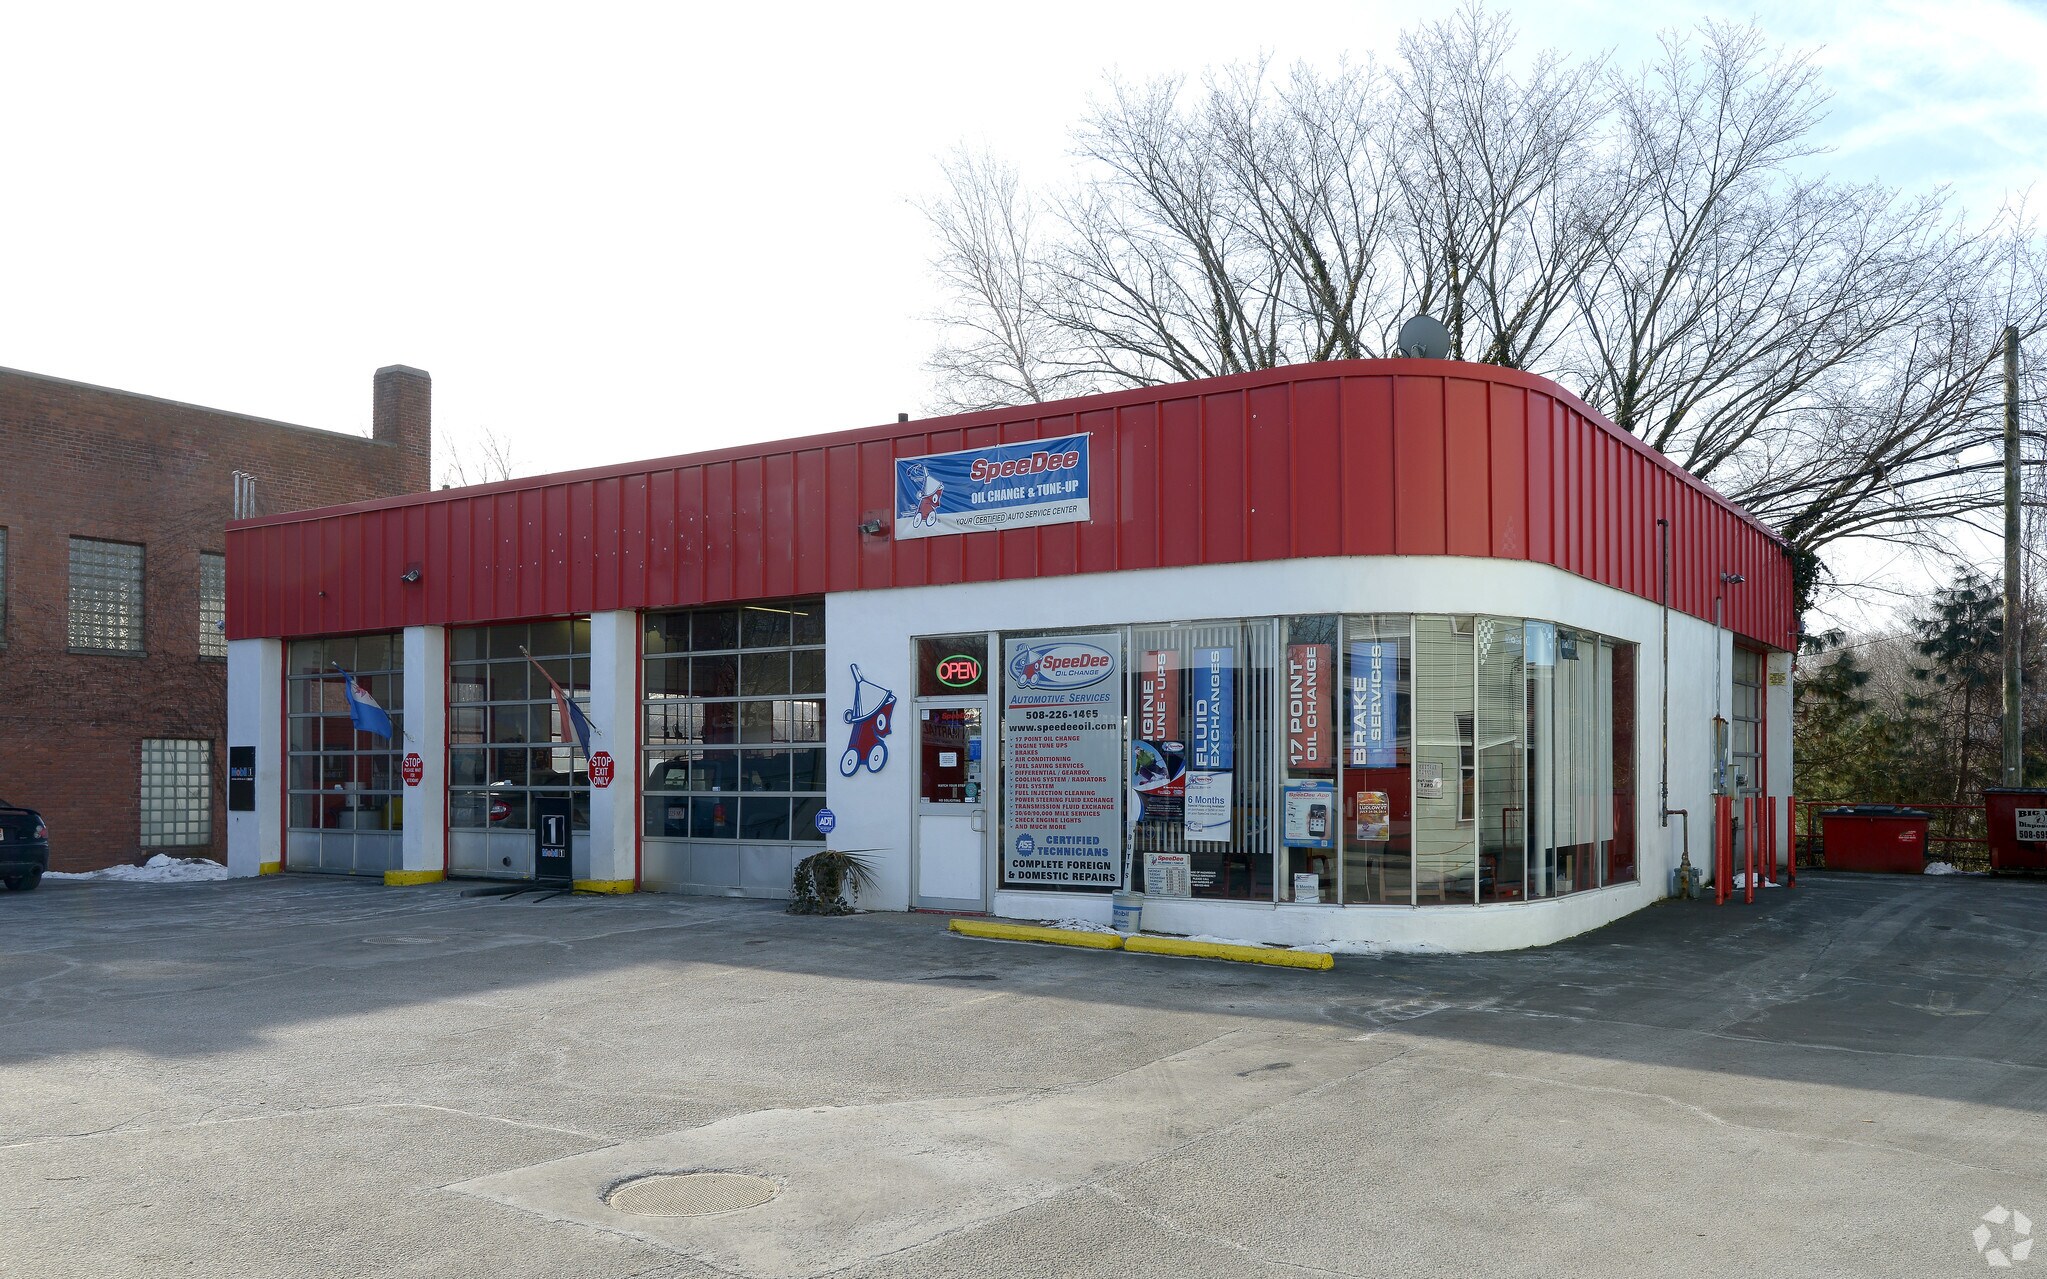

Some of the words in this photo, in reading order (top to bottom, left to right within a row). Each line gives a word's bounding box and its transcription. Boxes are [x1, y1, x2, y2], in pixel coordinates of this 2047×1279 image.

[970, 451, 1079, 484] SpeeDee
[971, 492, 986, 504] OIL
[988, 487, 1025, 502] CHANGE
[1028, 488, 1035, 497] &
[1036, 480, 1079, 496] TUNE-UP
[956, 517, 973, 525] YOUR
[975, 514, 1006, 524] CERTIFIED
[1008, 512, 1025, 520] AUTO
[1025, 508, 1050, 518] SERVICE
[1052, 505, 1078, 515] CENTER
[940, 662, 977, 680] OPEN
[1043, 654, 1109, 671] SpeeDee
[1307, 647, 1317, 727] CHANGE
[1371, 646, 1381, 740] SERVICES
[1011, 695, 1065, 704] AUTOMOTIVE
[1069, 694, 1110, 702] SERVICES
[1291, 660, 1302, 733] POINT
[1026, 710, 1098, 719] 508-226-1465
[1211, 651, 1220, 766] EXCHANGES
[1009, 722, 1116, 733] www.speedeeoil.com
[1157, 702, 1166, 741] UNE
[1354, 678, 1366, 764] BRAKE
[1196, 700, 1208, 766] FLUID
[1291, 739, 1302, 765] 17
[1307, 732, 1317, 760] OIL
[404, 757, 421, 767] STOP
[592, 756, 611, 767] STOP
[595, 767, 608, 776] EXIT
[594, 776, 609, 785] ONLY
[1195, 796, 1225, 804] Months
[819, 816, 832, 826] ADT
[548, 817, 556, 844] 1
[1046, 836, 1100, 845] CERTIFIED
[1037, 847, 1108, 856] TECHNICIANS
[1012, 860, 1063, 869] COMPLETE
[1067, 861, 1111, 870] FOREIGN
[1018, 871, 1068, 880] DOMESTIC
[1072, 872, 1115, 882] REPAIRS
